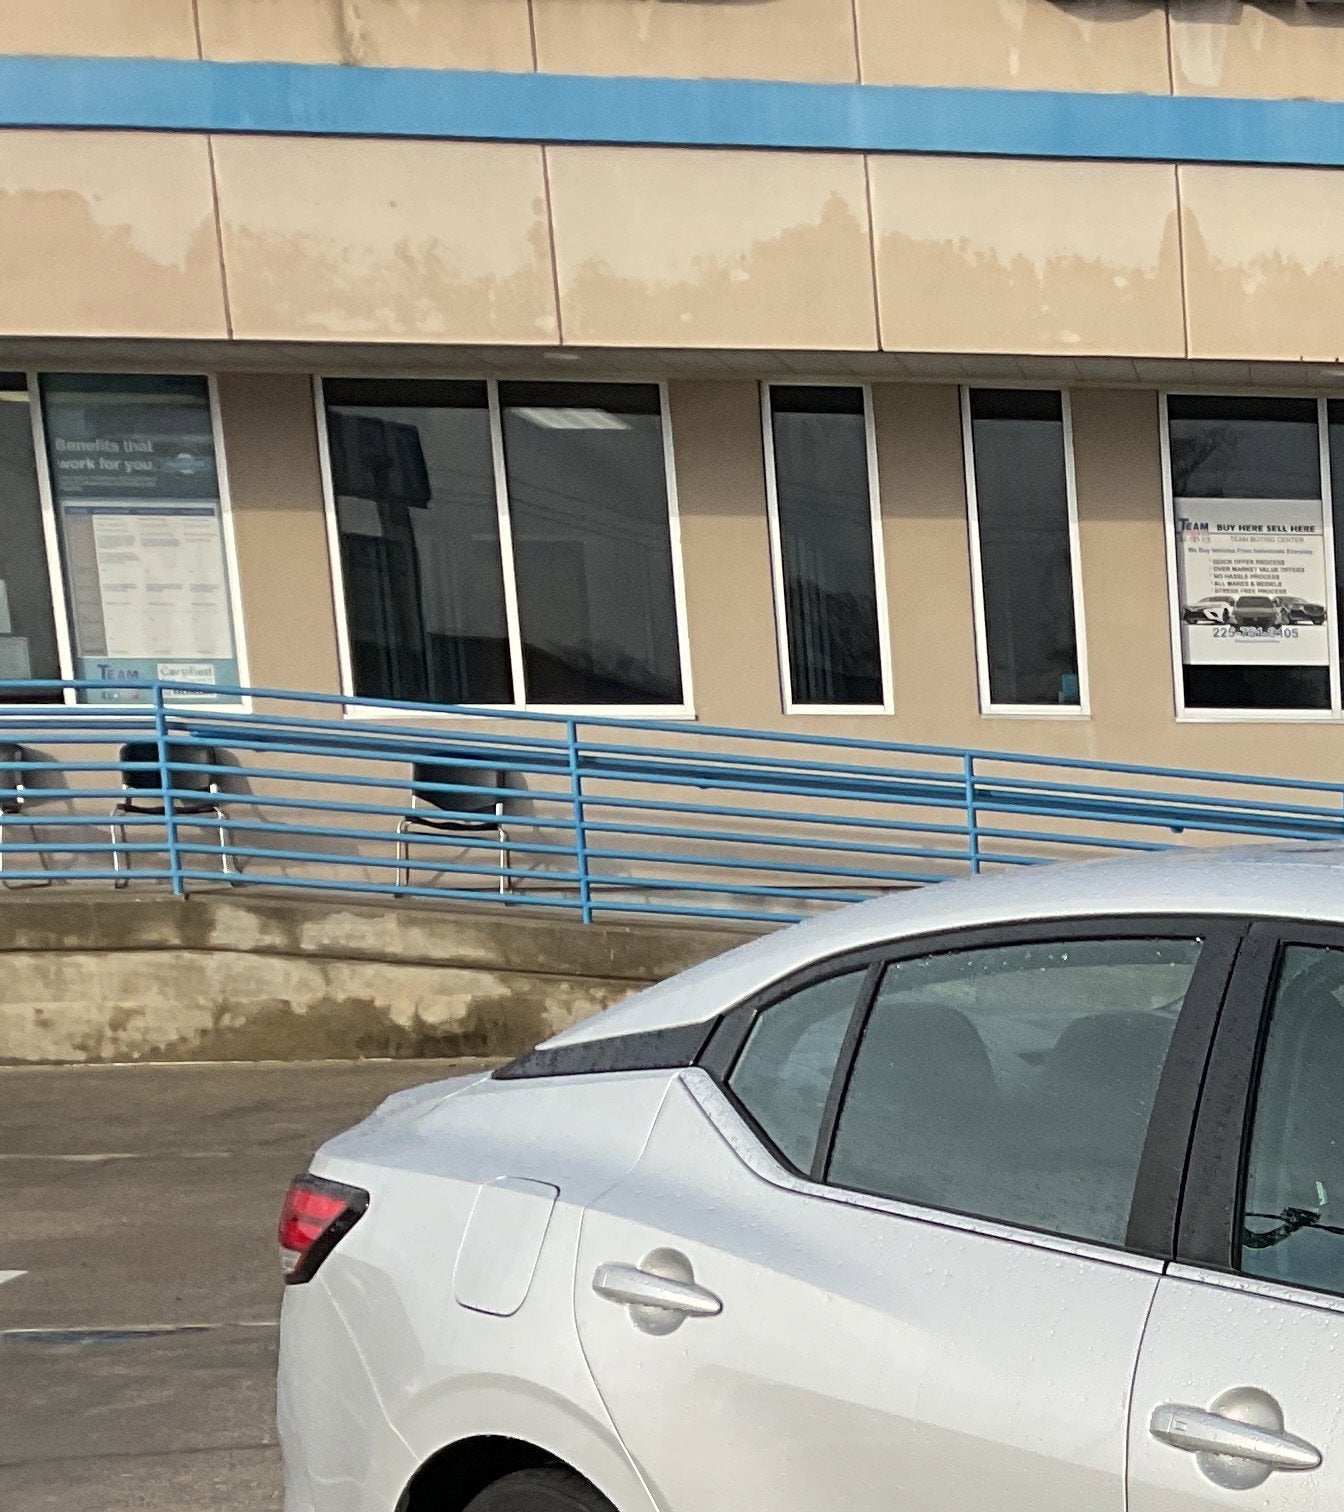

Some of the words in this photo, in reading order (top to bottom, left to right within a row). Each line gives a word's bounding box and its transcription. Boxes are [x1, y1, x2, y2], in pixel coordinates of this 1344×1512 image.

[123, 440, 154, 452] that
[58, 457, 95, 470] work
[99, 457, 120, 470] for
[1238, 524, 1263, 532] HERE
[1290, 525, 1315, 533] HERE
